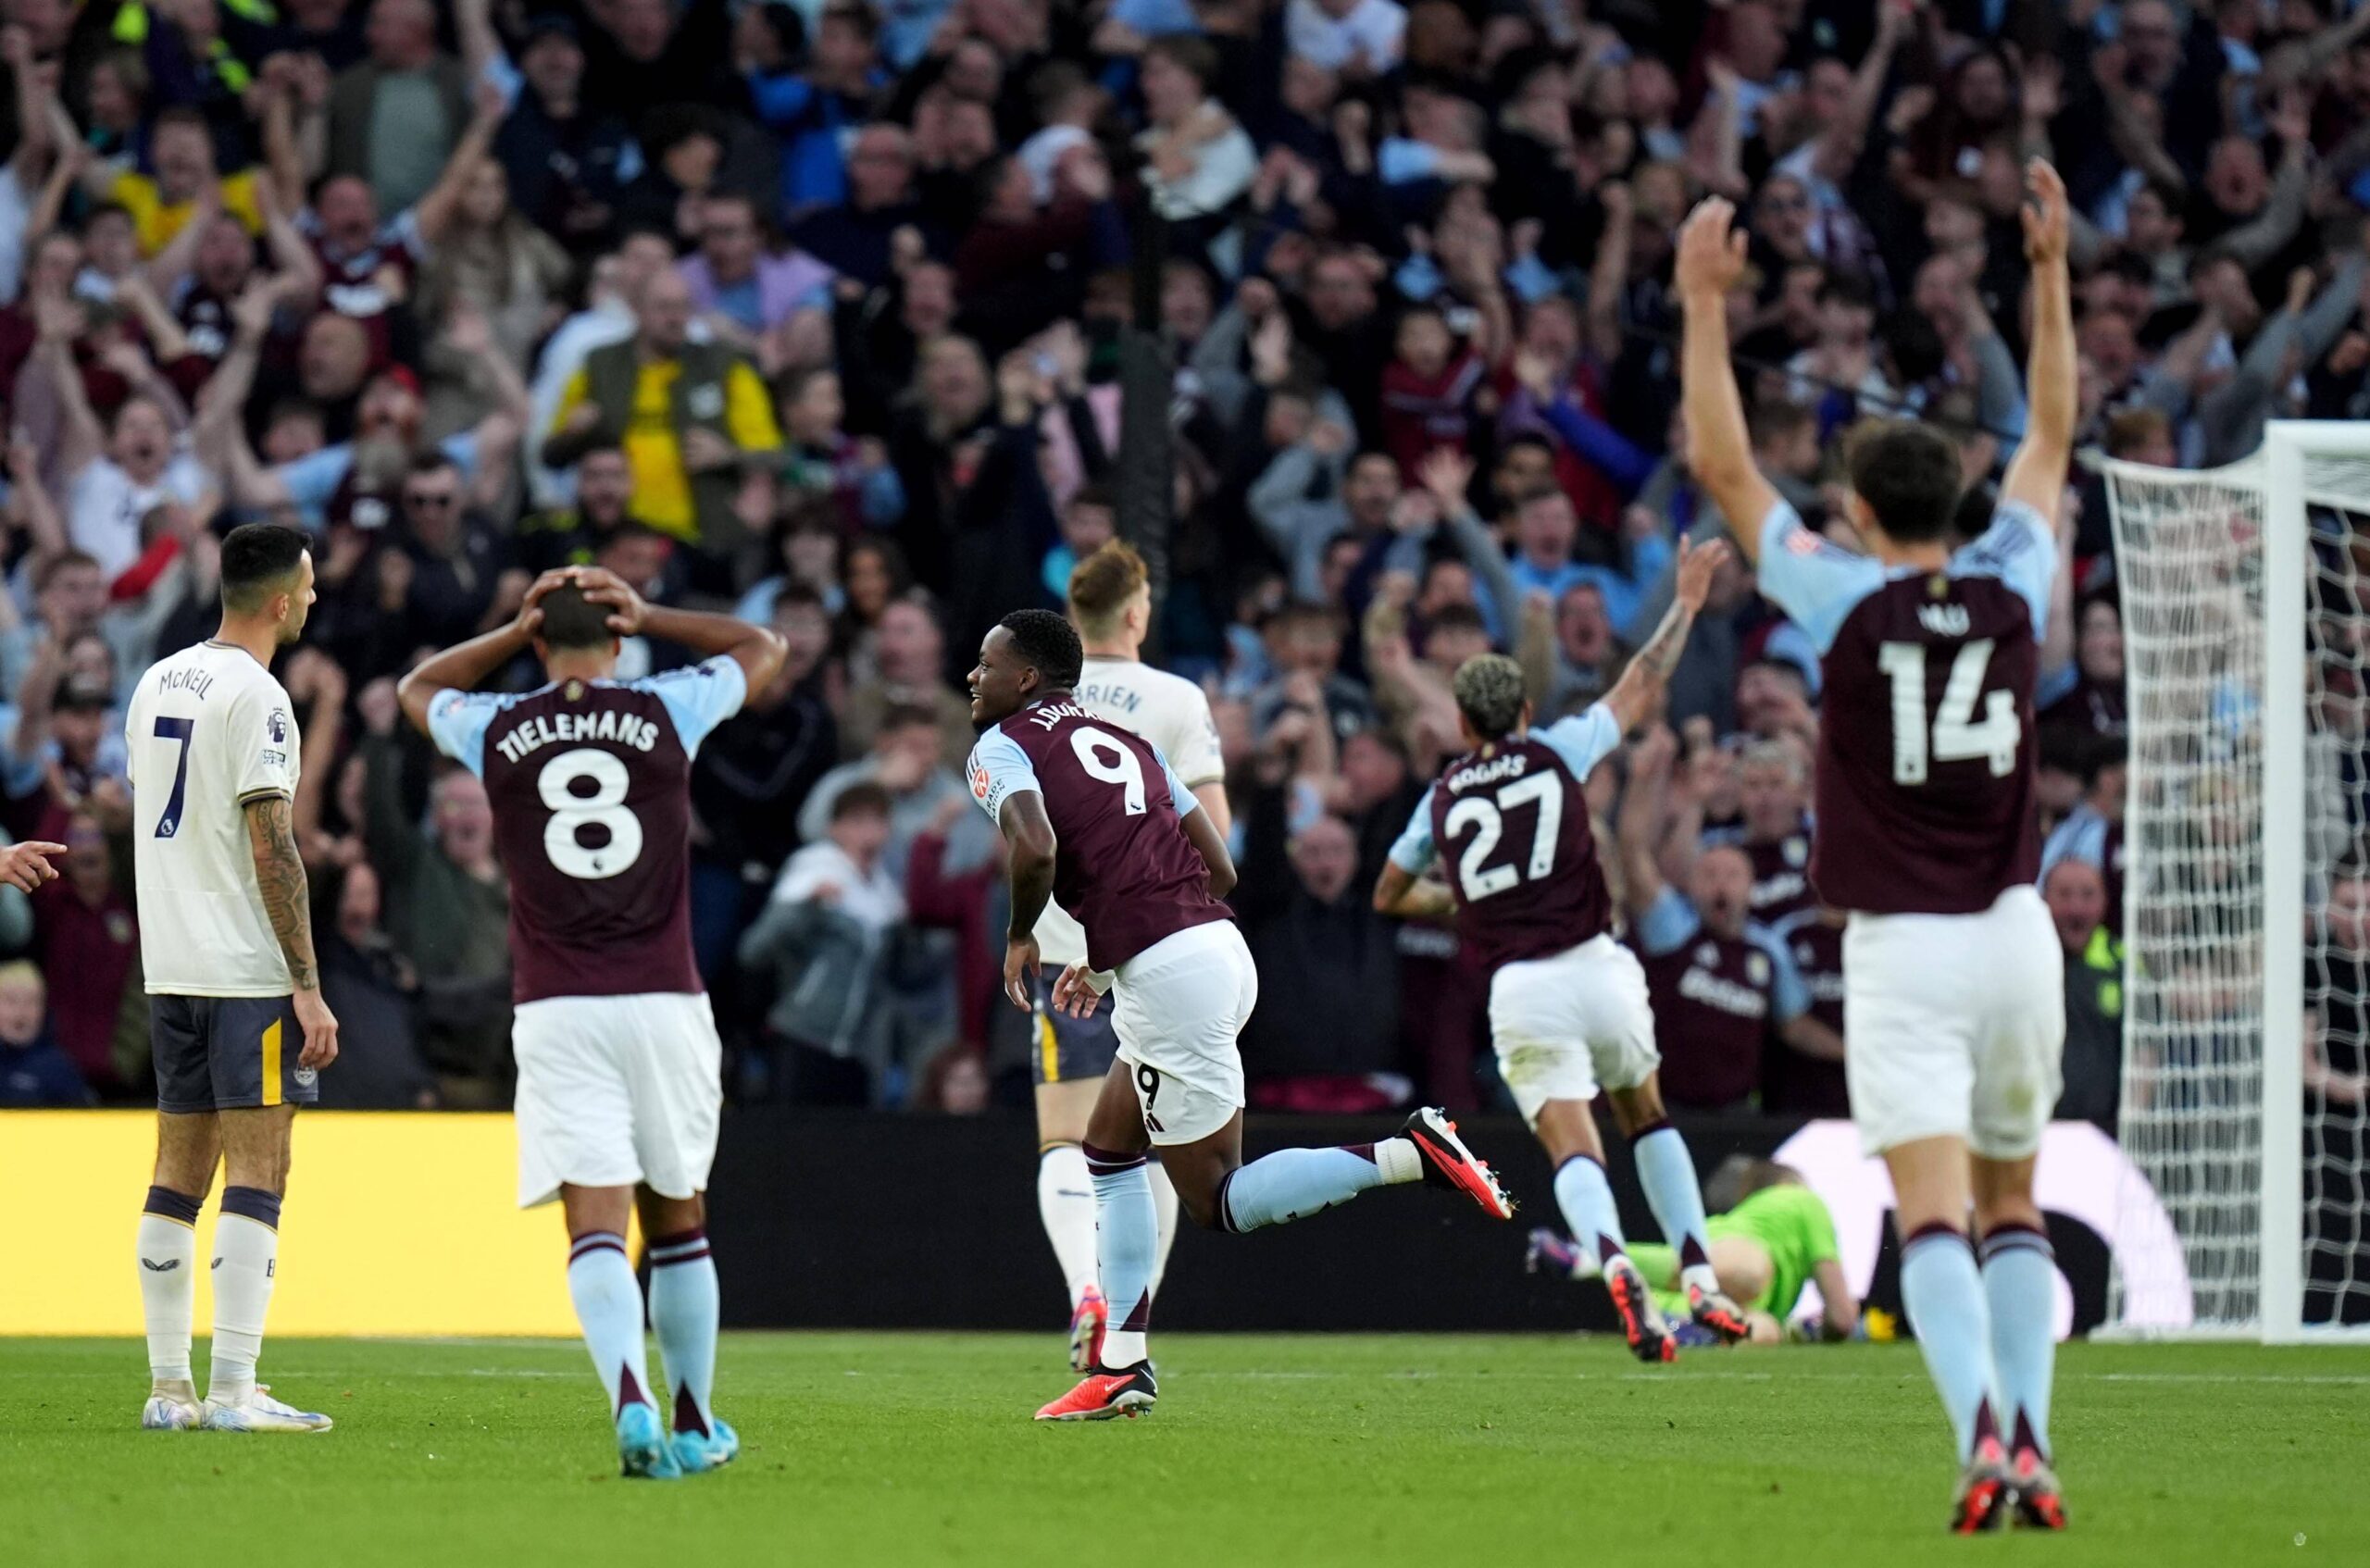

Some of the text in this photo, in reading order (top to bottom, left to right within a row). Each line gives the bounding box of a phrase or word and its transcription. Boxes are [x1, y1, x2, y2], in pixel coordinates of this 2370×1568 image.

[159, 668, 213, 701] McNEIL
[495, 710, 659, 764] TIELEMANS
[1877, 637, 2022, 785] 14
[154, 716, 194, 839] 7
[537, 748, 643, 879] 8
[1070, 727, 1147, 815] 9
[1444, 769, 1564, 902] 27
[1137, 1063, 1160, 1110] 9
